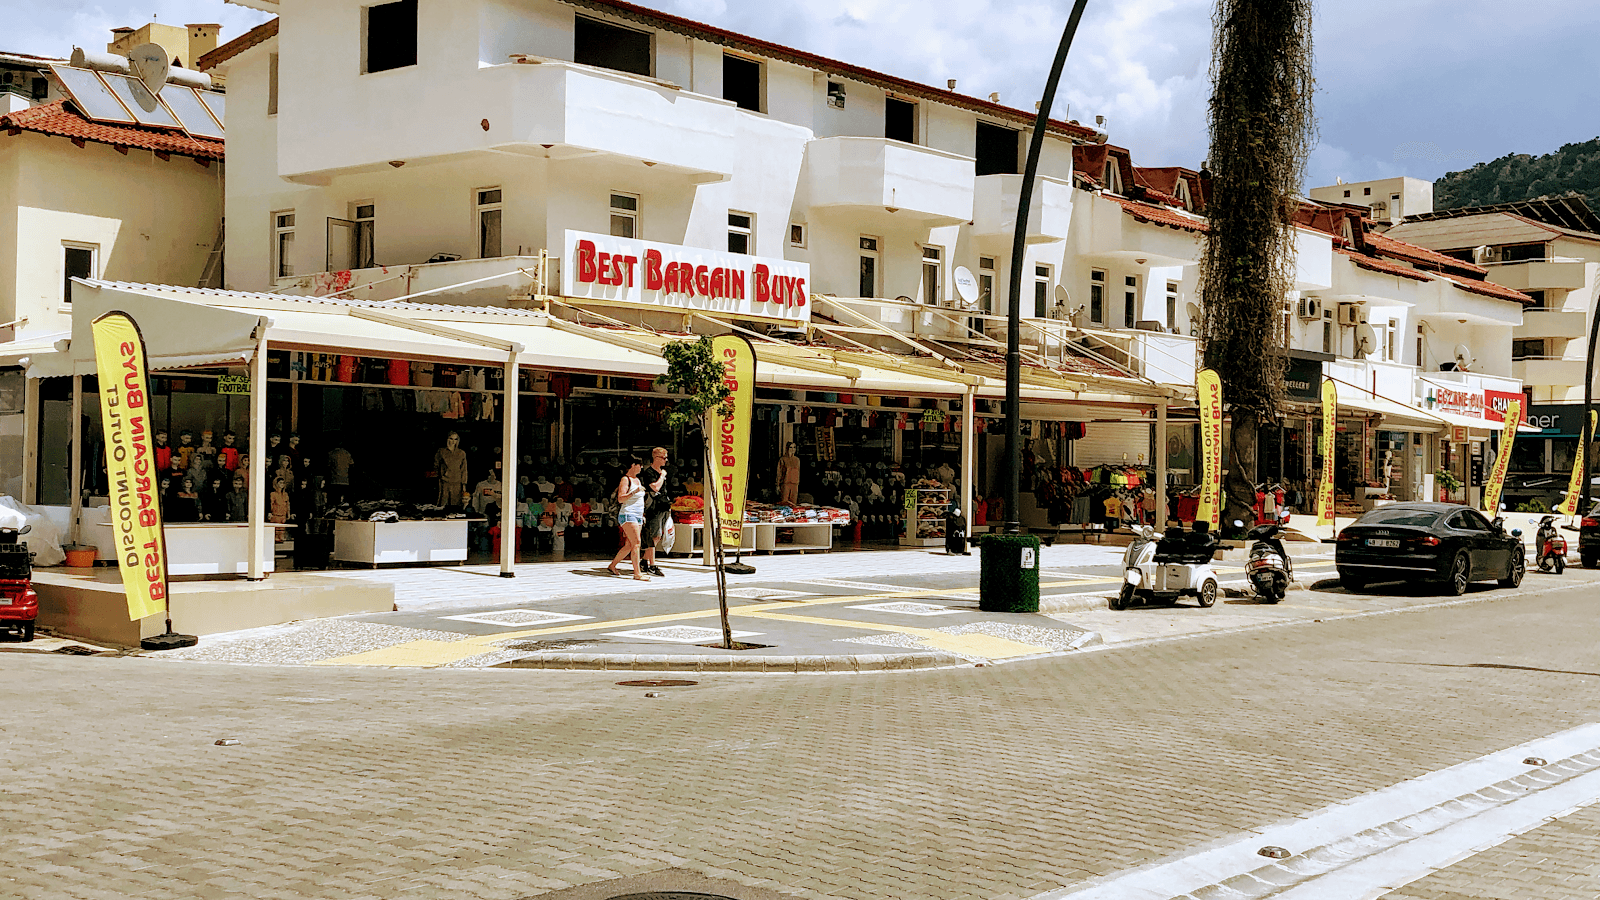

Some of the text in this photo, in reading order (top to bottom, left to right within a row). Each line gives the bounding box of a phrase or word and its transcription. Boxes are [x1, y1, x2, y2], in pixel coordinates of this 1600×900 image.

[577, 239, 806, 309] BEST BARGAIN BUYS
